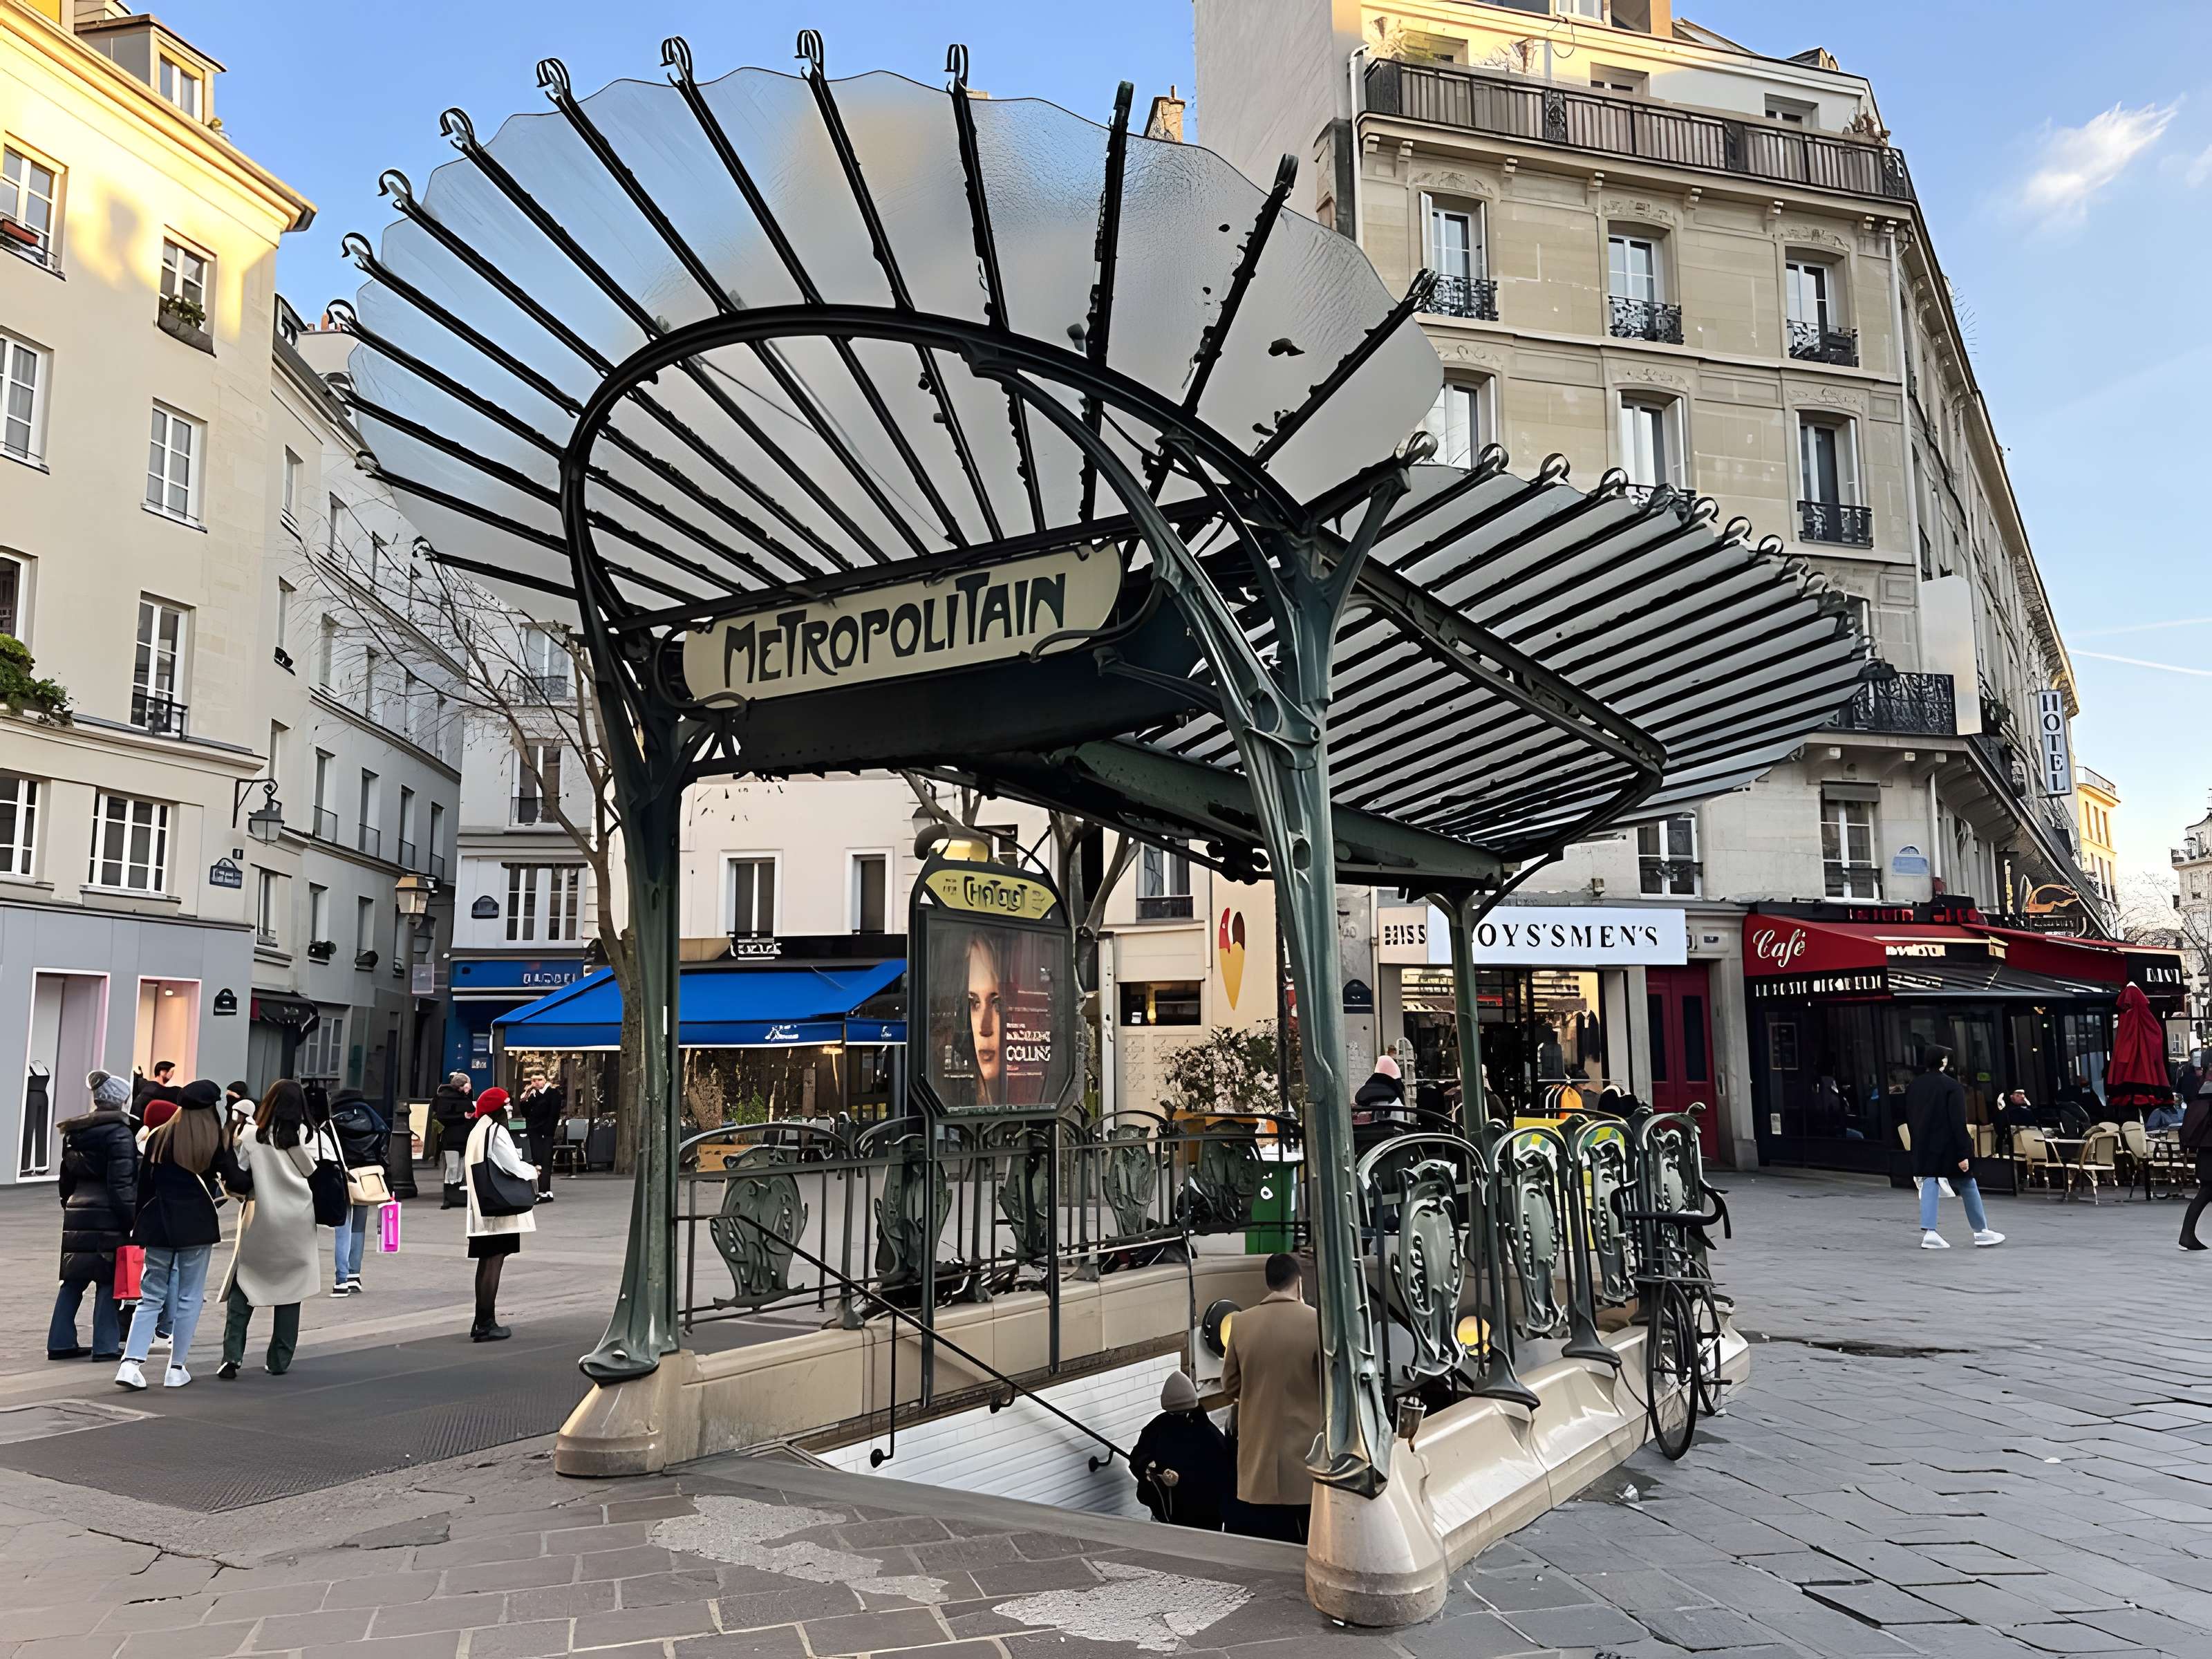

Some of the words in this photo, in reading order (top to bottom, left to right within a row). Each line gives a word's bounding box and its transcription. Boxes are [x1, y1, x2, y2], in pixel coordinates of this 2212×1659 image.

[724, 571, 1066, 688] METROPOLITAIN
[2042, 694, 2066, 791] HOTEL
[1752, 928, 1806, 968] Café
